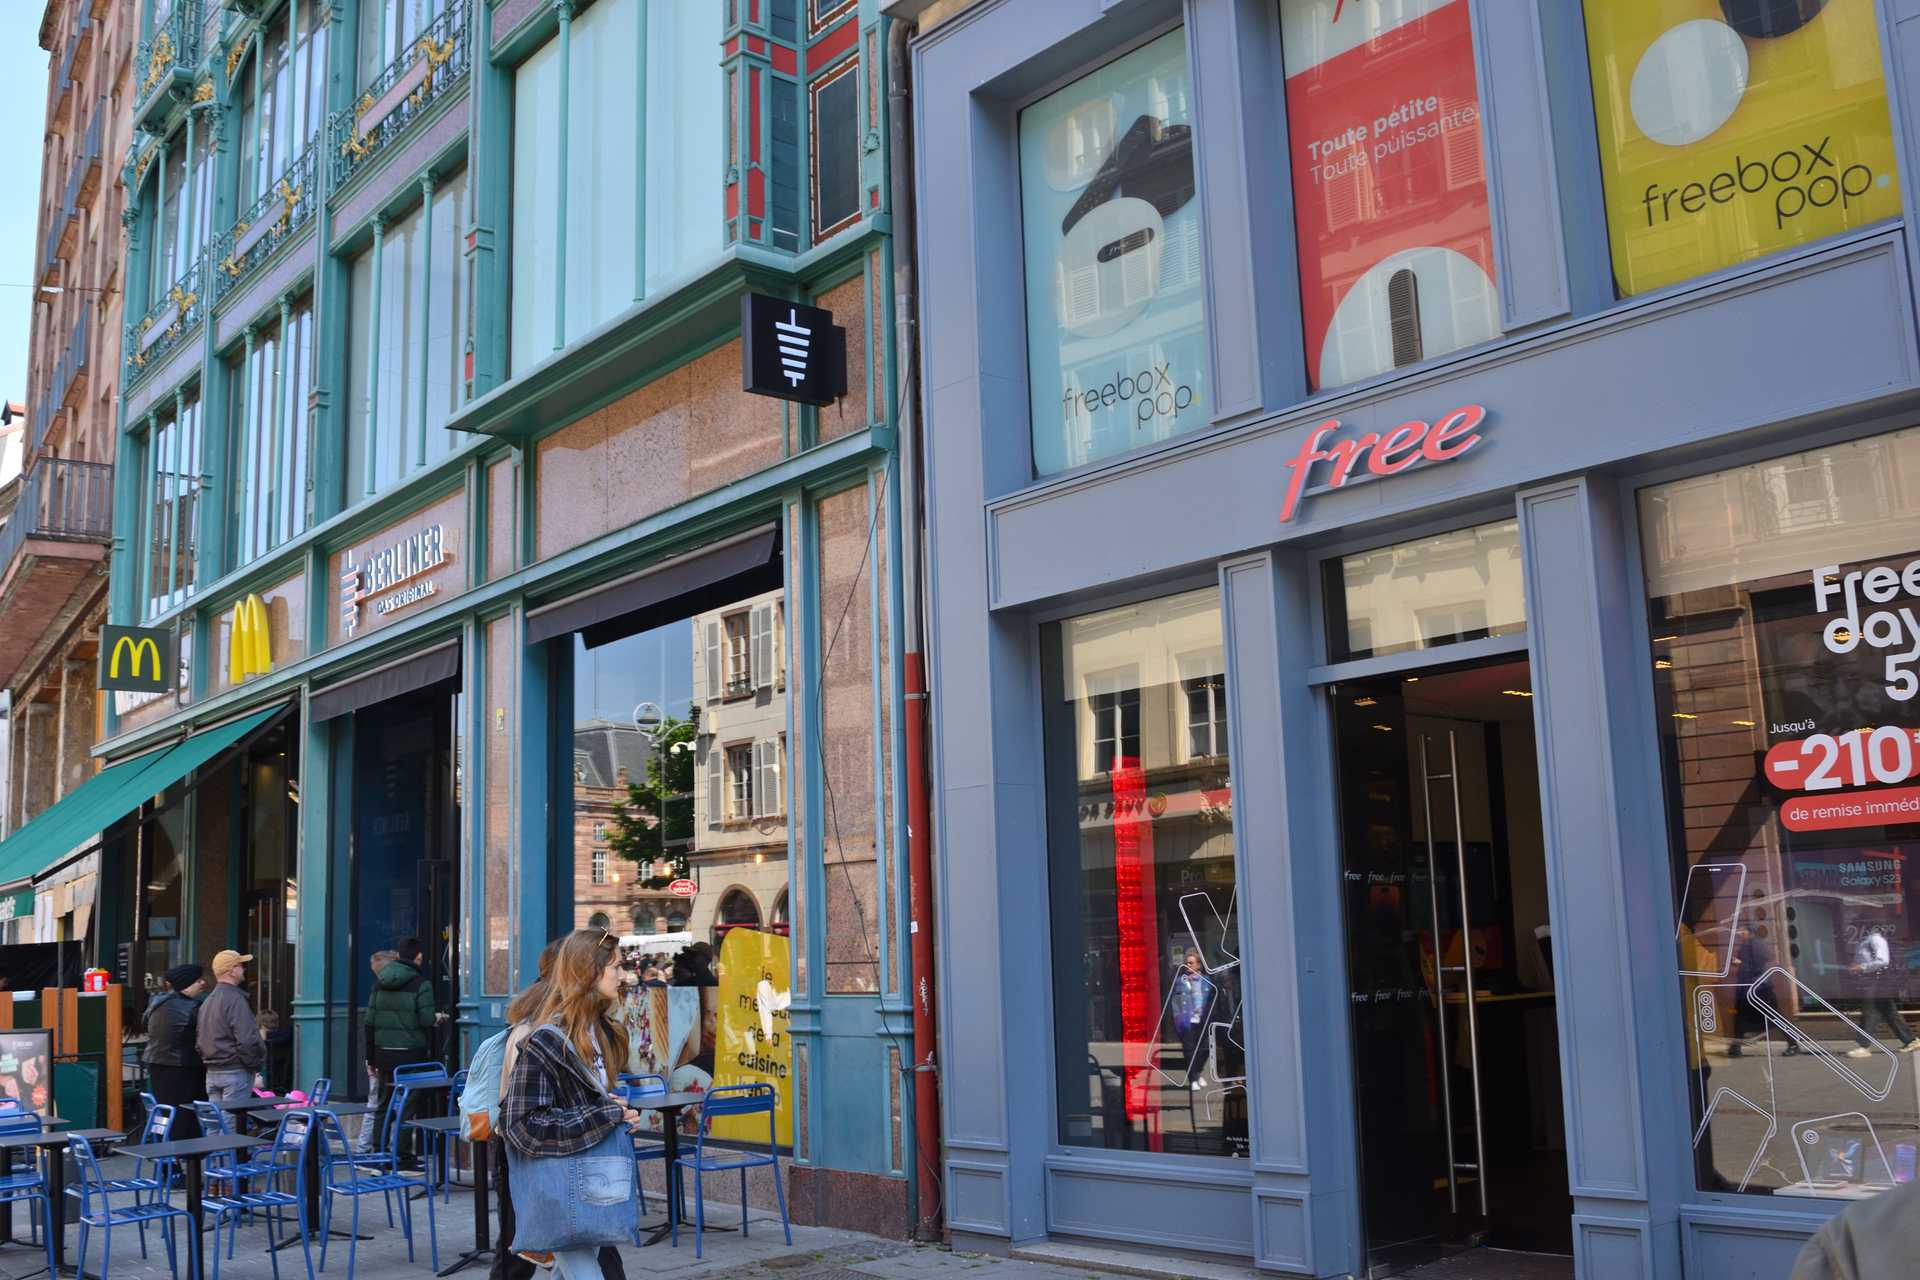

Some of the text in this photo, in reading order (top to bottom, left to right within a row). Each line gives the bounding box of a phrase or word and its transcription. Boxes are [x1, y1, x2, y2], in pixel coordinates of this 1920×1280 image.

[1307, 96, 1437, 160] Toute petite
[1310, 106, 1475, 185] Toute puissante
[1642, 136, 1834, 227] freebox
[1063, 362, 1172, 421] freebox
[1279, 403, 1485, 523] free
[364, 524, 444, 598] BERLINER
[377, 580, 434, 615] DAS ORIGINAL
[1769, 718, 1816, 734] Jusqu'à
[1790, 808, 1809, 821] de
[1813, 802, 1862, 819] remise
[1838, 859, 1901, 873] SAMSUNG
[738, 1050, 787, 1079] cuisine
